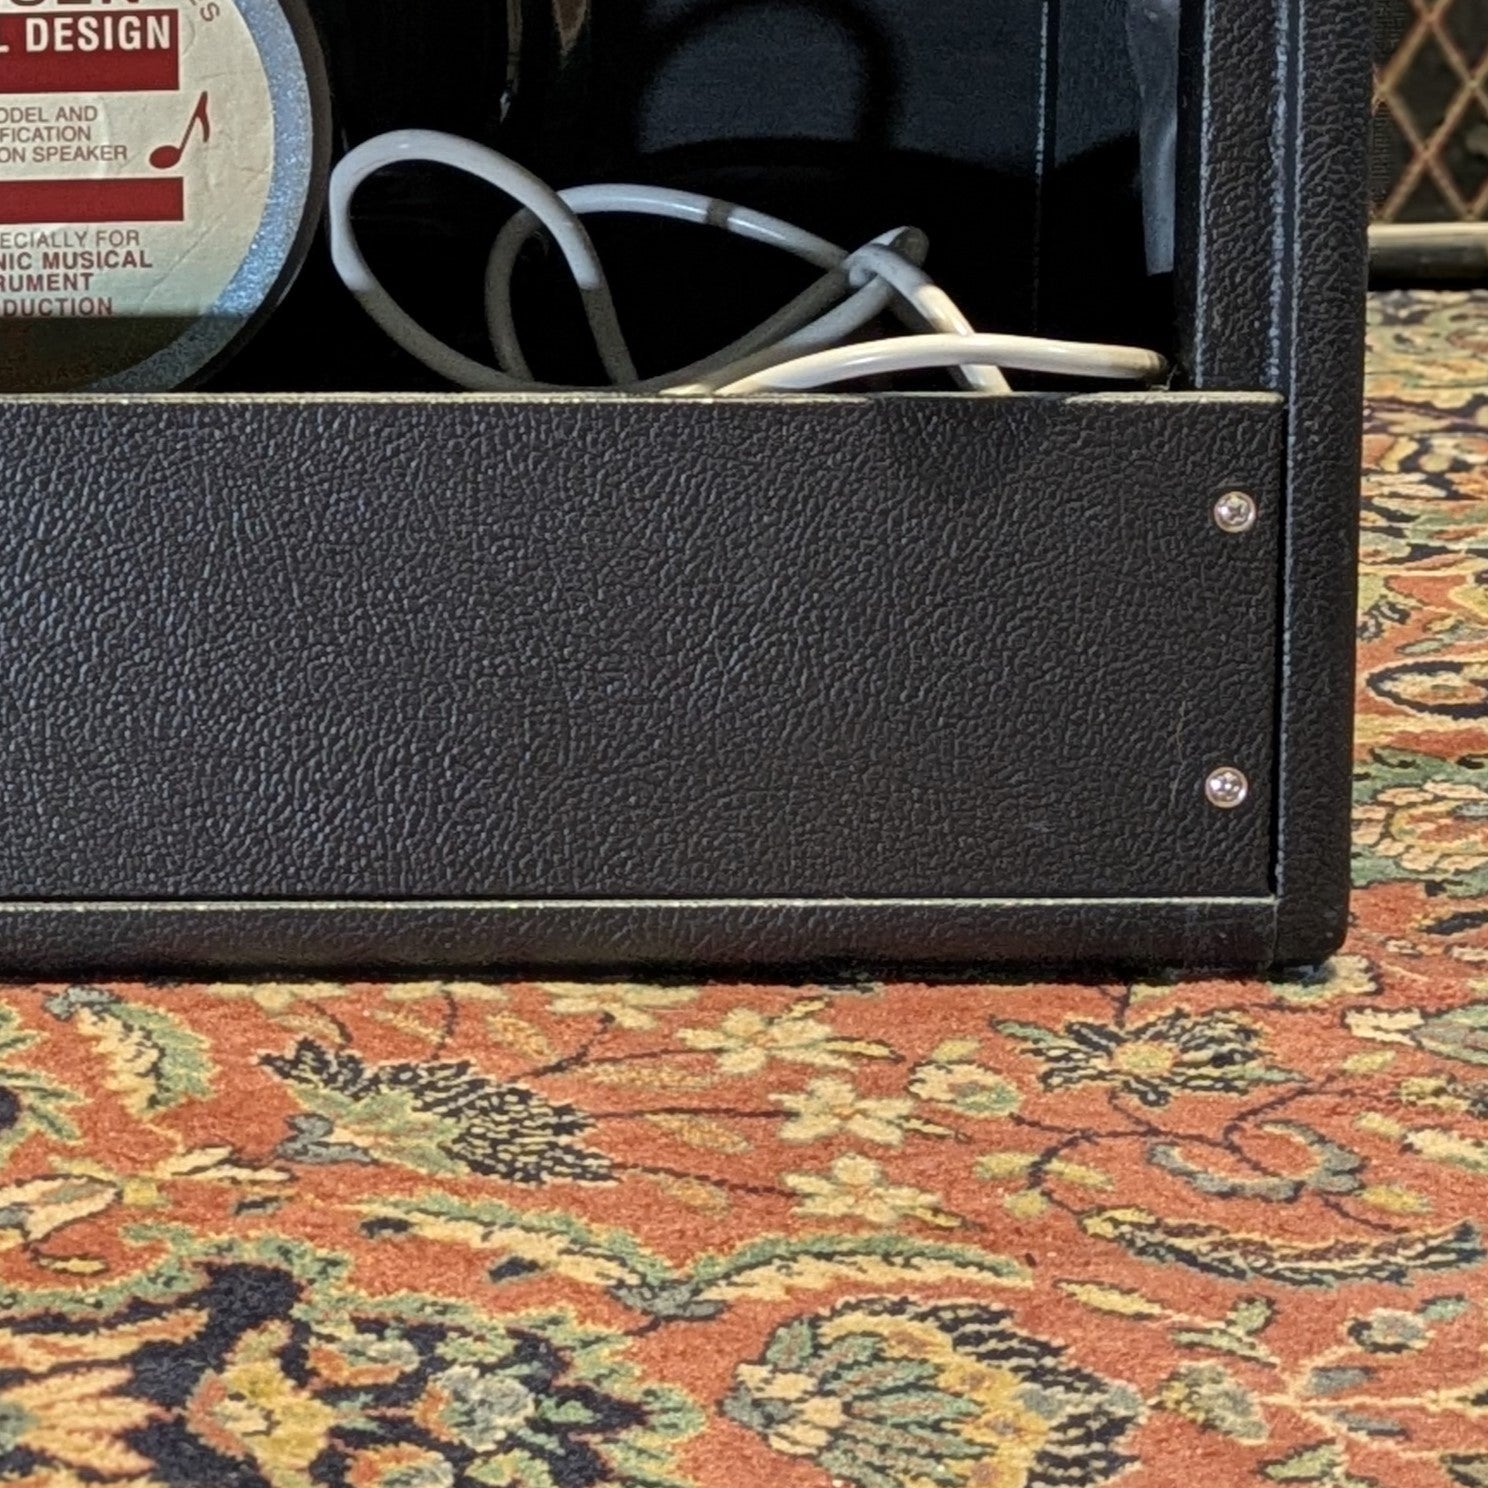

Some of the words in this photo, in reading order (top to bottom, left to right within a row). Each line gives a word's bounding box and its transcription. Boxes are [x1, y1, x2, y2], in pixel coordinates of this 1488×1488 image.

[25, 14, 172, 53] DESIGN
[55, 105, 99, 122] AND
[40, 144, 128, 163] SPEAKER
[96, 229, 140, 247] FOR
[42, 249, 153, 271] MUSICAL
